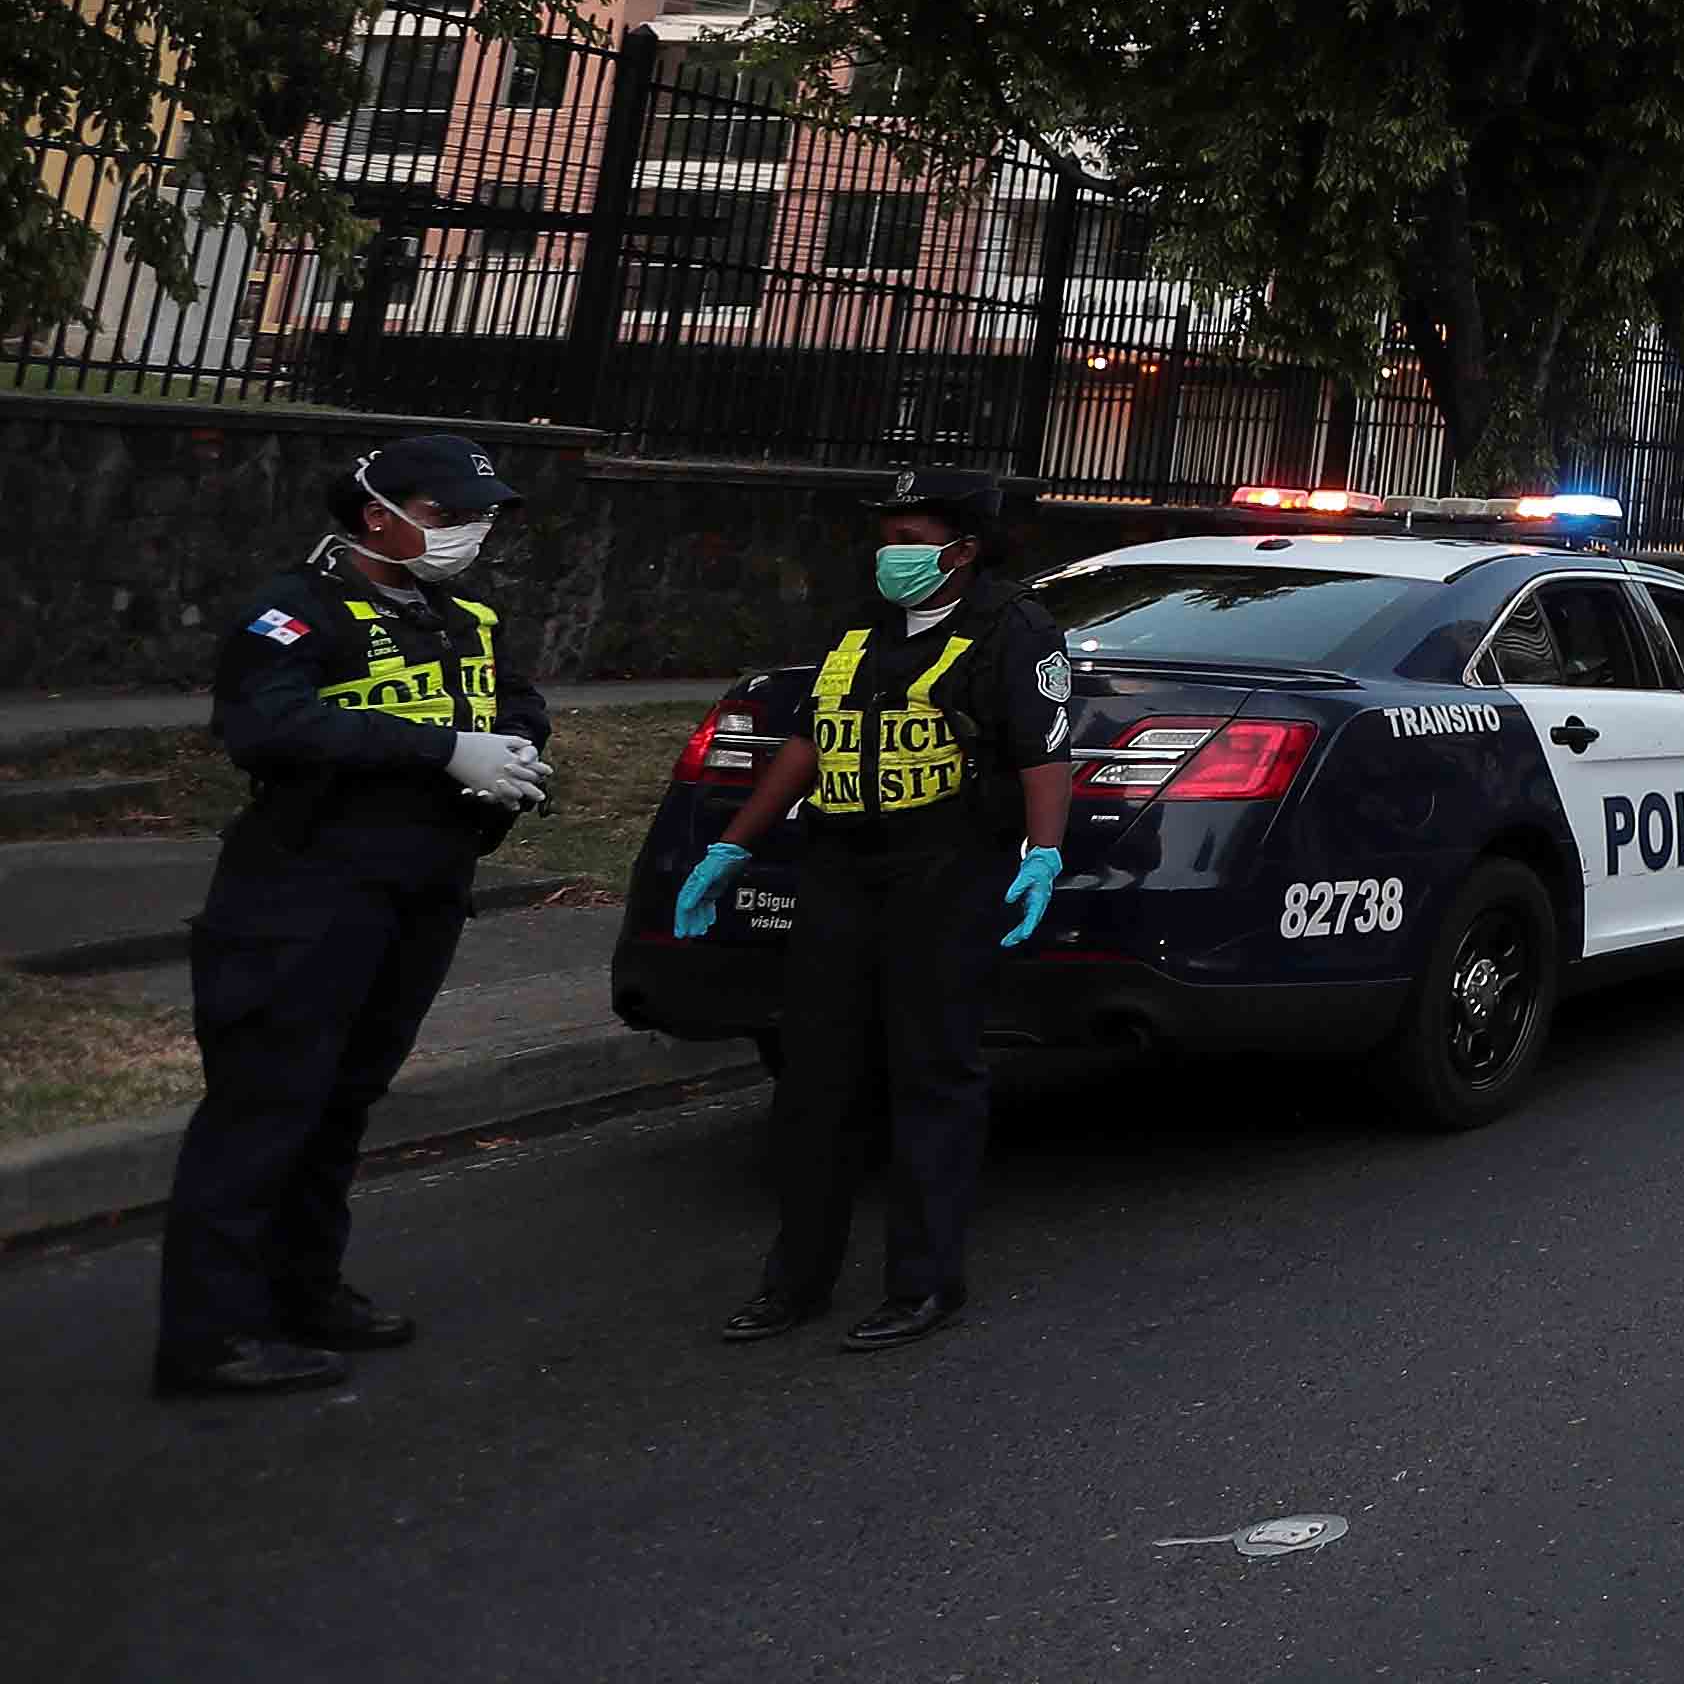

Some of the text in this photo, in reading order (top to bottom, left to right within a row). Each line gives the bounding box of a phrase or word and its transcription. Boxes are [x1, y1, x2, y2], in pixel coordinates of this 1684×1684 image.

[815, 717, 957, 753] OLICI
[1384, 703, 1500, 739] TRANSITO
[818, 762, 956, 804] ANSIT
[1279, 876, 1404, 939] 82738
